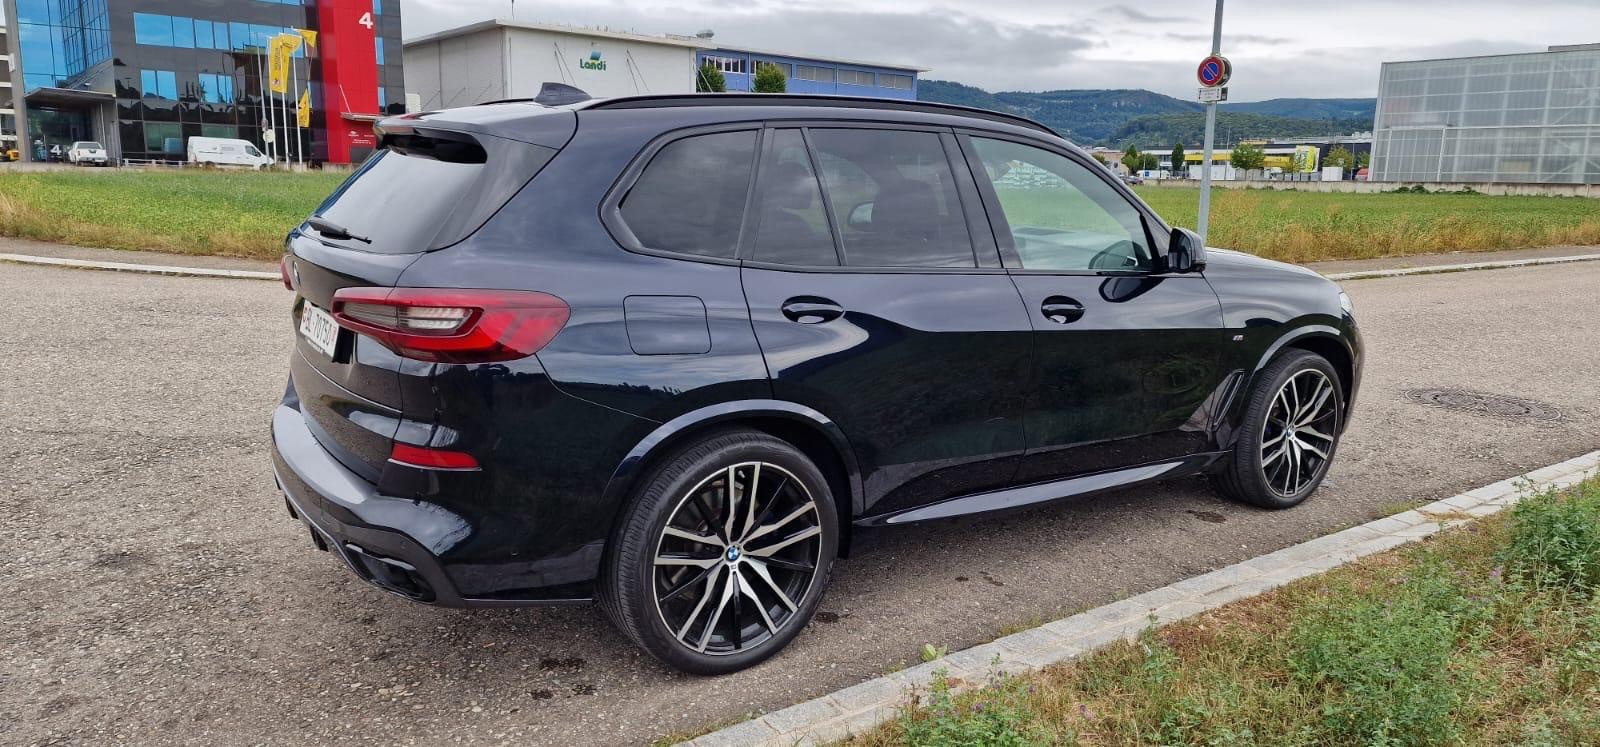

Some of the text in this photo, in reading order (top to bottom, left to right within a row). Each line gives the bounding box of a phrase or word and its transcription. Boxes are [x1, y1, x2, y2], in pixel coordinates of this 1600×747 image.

[359, 12, 373, 29] 4
[580, 58, 606, 71] Landi
[50, 144, 62, 155] 4
